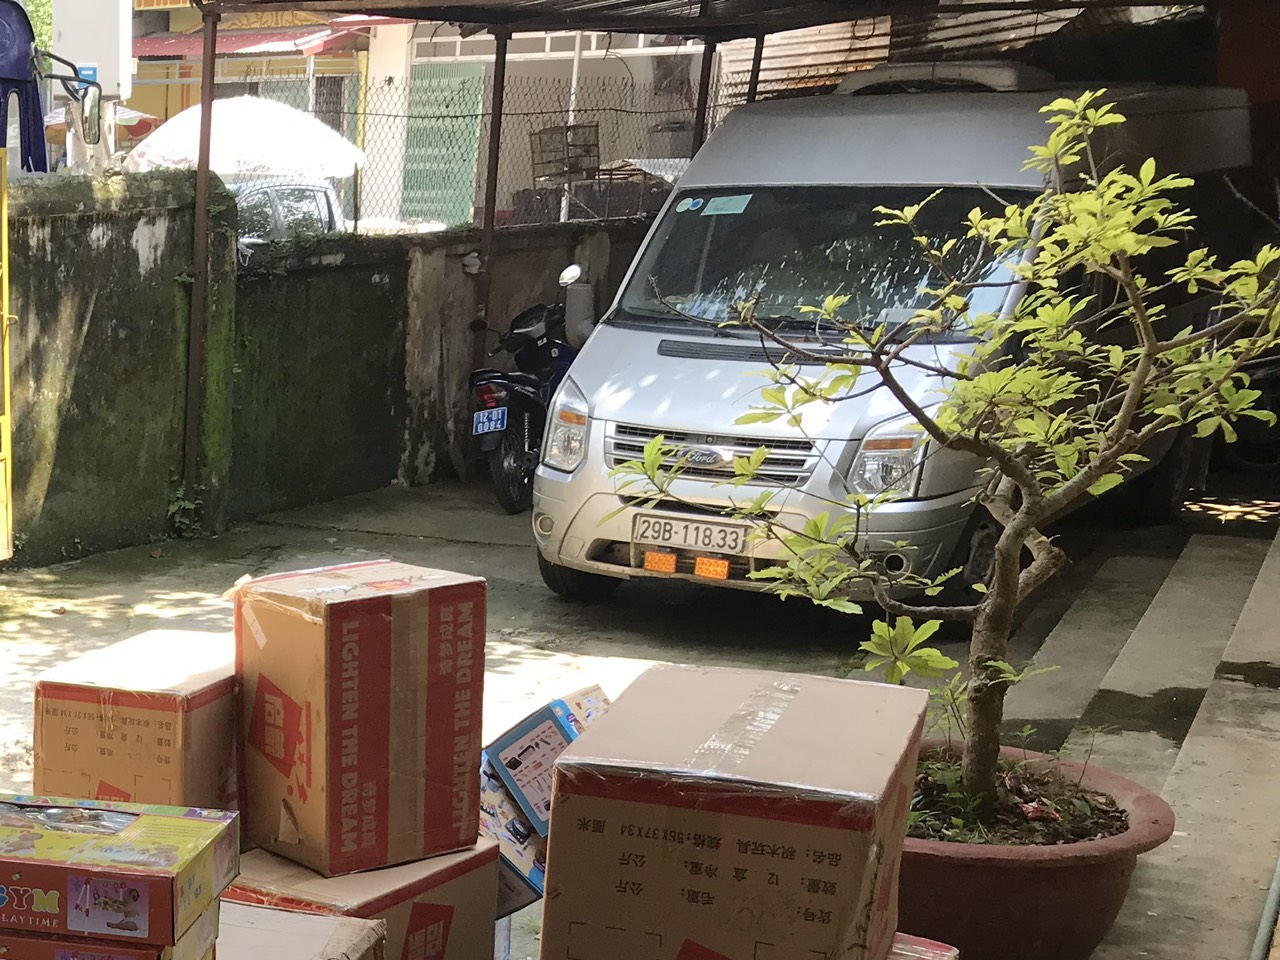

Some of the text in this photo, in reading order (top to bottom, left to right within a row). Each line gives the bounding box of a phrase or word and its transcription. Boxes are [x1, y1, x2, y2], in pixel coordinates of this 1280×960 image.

[477, 420, 502, 432] 0084
[688, 448, 715, 465] Ford
[638, 518, 741, 551] 29B-118.33
[454, 601, 474, 731] THE DREAM
[340, 619, 360, 851] LIGHTEN THE DREAM
[576, 816, 607, 834] 厘米
[735, 838, 797, 861] 积木玩具
[617, 852, 647, 869] 公斤
[732, 866, 748, 882] 盒
[766, 872, 780, 886] 12
[615, 879, 644, 896] 公斤
